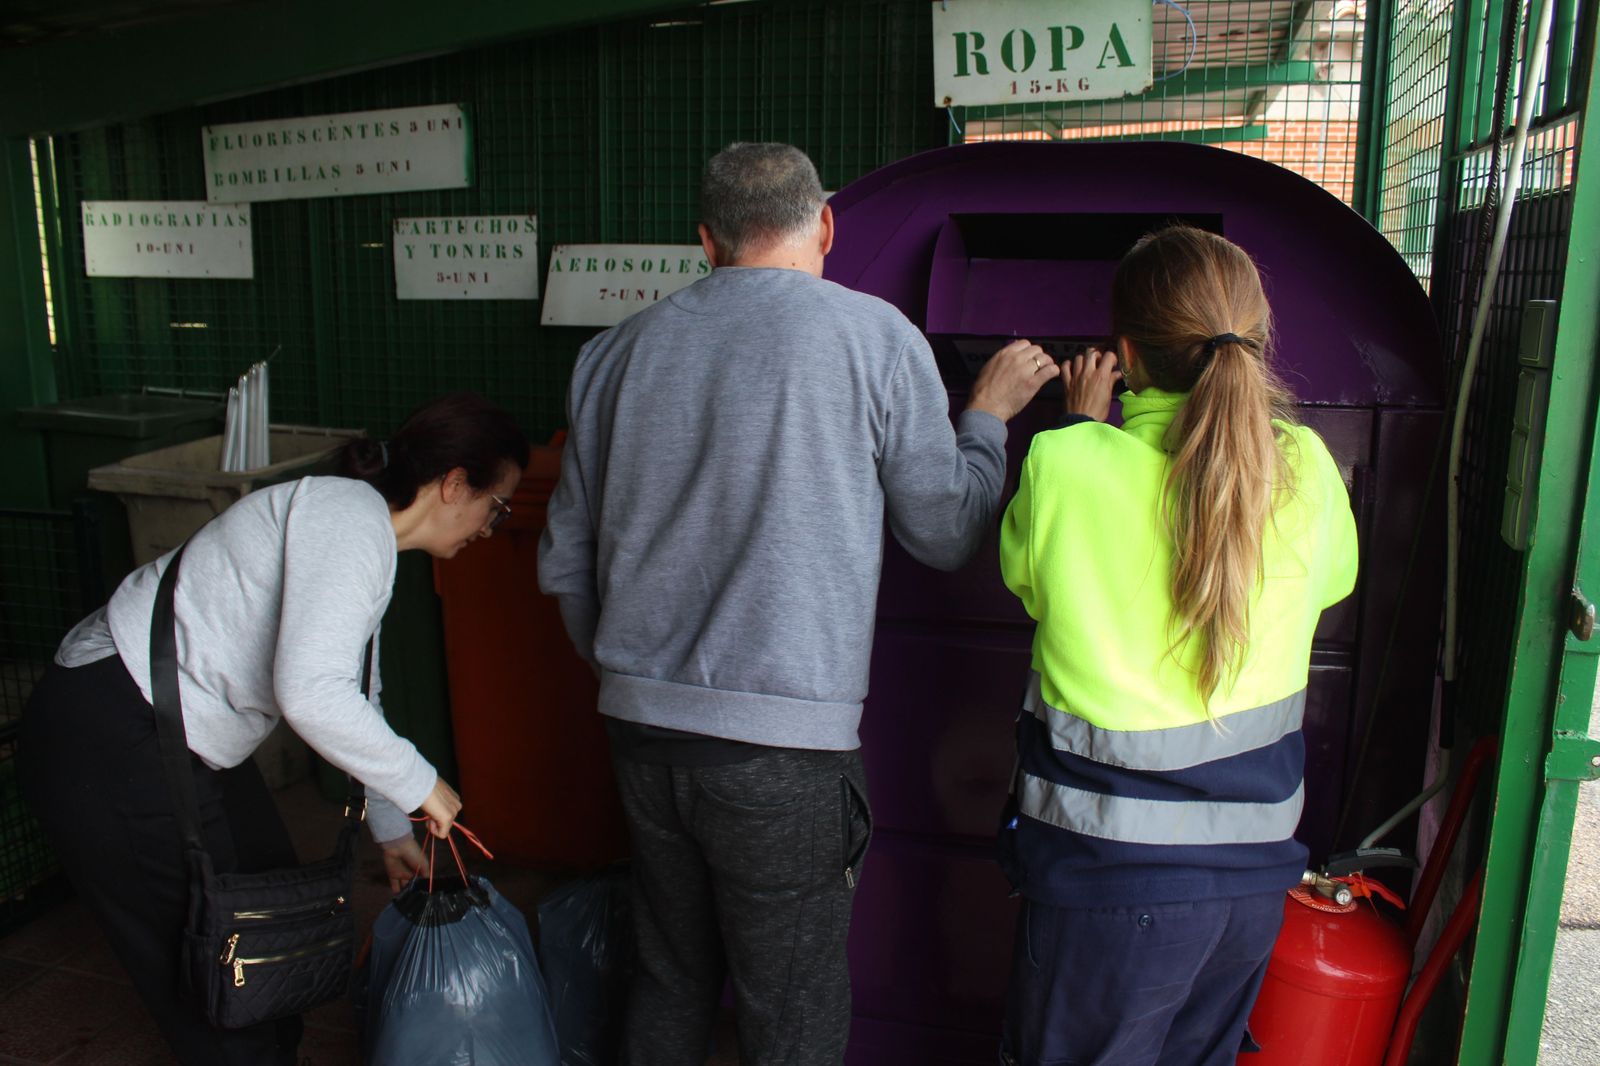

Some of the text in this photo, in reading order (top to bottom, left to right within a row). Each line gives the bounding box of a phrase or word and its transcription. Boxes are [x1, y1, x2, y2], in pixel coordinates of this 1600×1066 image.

[952, 22, 1136, 77] ROPA
[1009, 77, 1090, 95] 15-KG
[209, 121, 400, 151] FLUORESCENTES
[427, 117, 464, 132] UNI
[214, 164, 342, 187] BOMBILLAS
[376, 159, 412, 174] UNI
[85, 212, 249, 227] RADIOGRAFIAS
[394, 219, 536, 235] CARTUCHOS
[135, 242, 195, 255] 10-UNI
[405, 244, 524, 259] Y TONERS
[550, 257, 709, 274] AEROSOLES
[599, 288, 660, 301] 7-UNI
